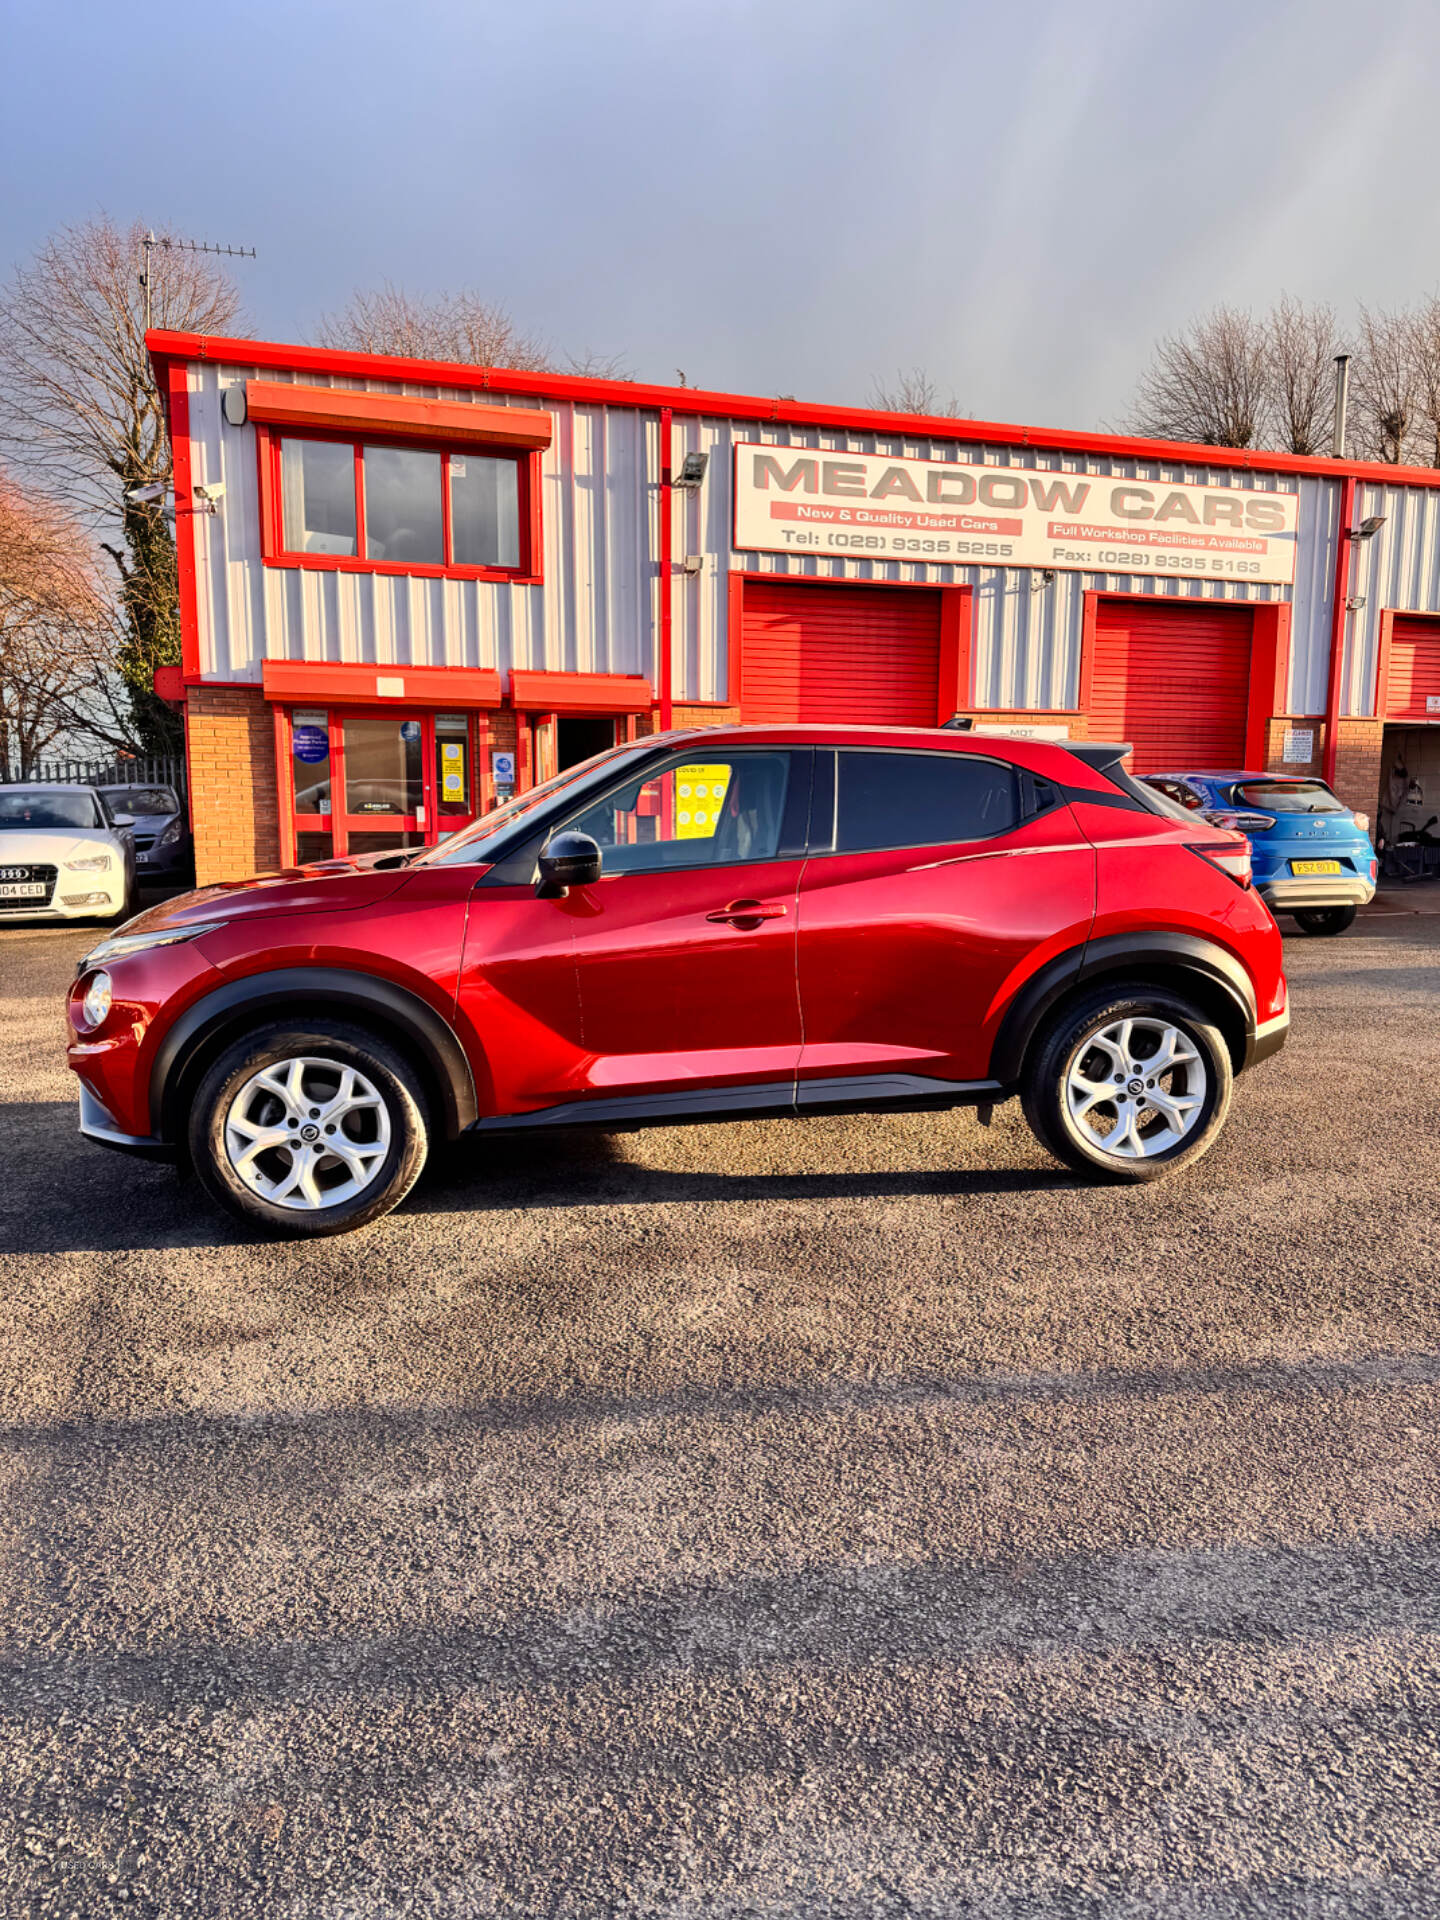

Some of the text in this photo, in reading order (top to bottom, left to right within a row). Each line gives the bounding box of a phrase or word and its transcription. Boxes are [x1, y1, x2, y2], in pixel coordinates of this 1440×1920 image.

[753, 453, 1286, 531] MEADOW CARS
[797, 505, 999, 531] New & Quality Used Cars
[781, 529, 1013, 557] Tel: (028) 9335 5255
[1053, 525, 1263, 551] Full Workshop Facilities Available
[1052, 547, 1261, 574] Fax: (028) 9335 5163
[1009, 728, 1035, 737] MOT
[1297, 863, 1315, 873] FSZ
[0, 885, 17, 896] 04
